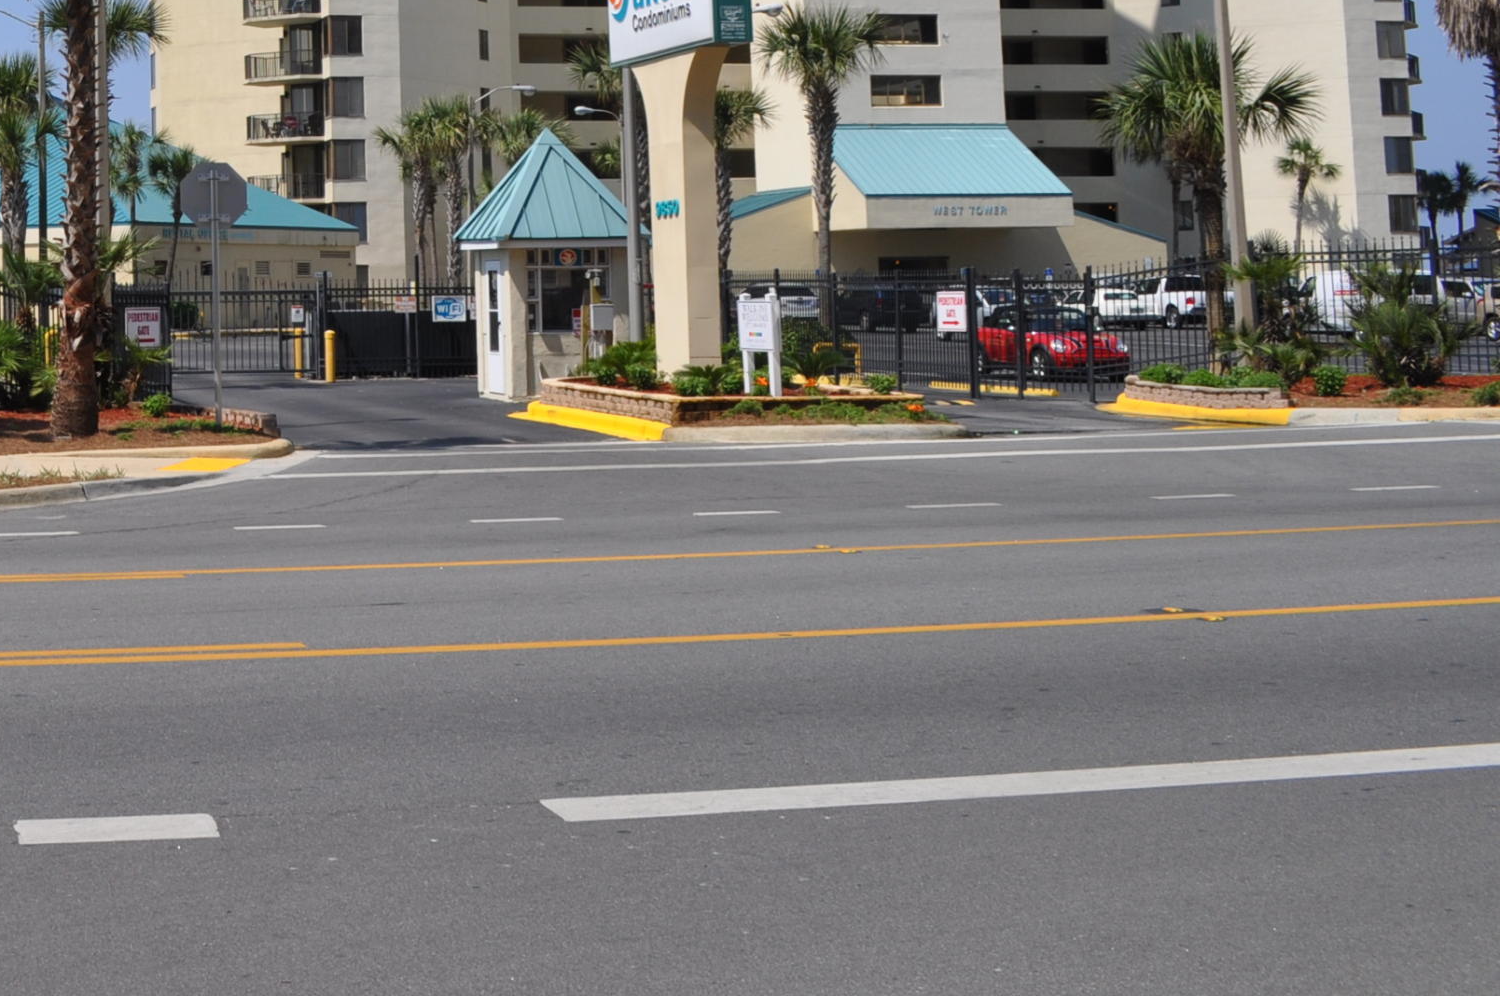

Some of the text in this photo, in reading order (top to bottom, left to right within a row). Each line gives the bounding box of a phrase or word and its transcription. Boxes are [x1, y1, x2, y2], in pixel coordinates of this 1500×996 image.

[632, 3, 691, 33] Condominiums
[933, 205, 1008, 217] WEST TOWER
